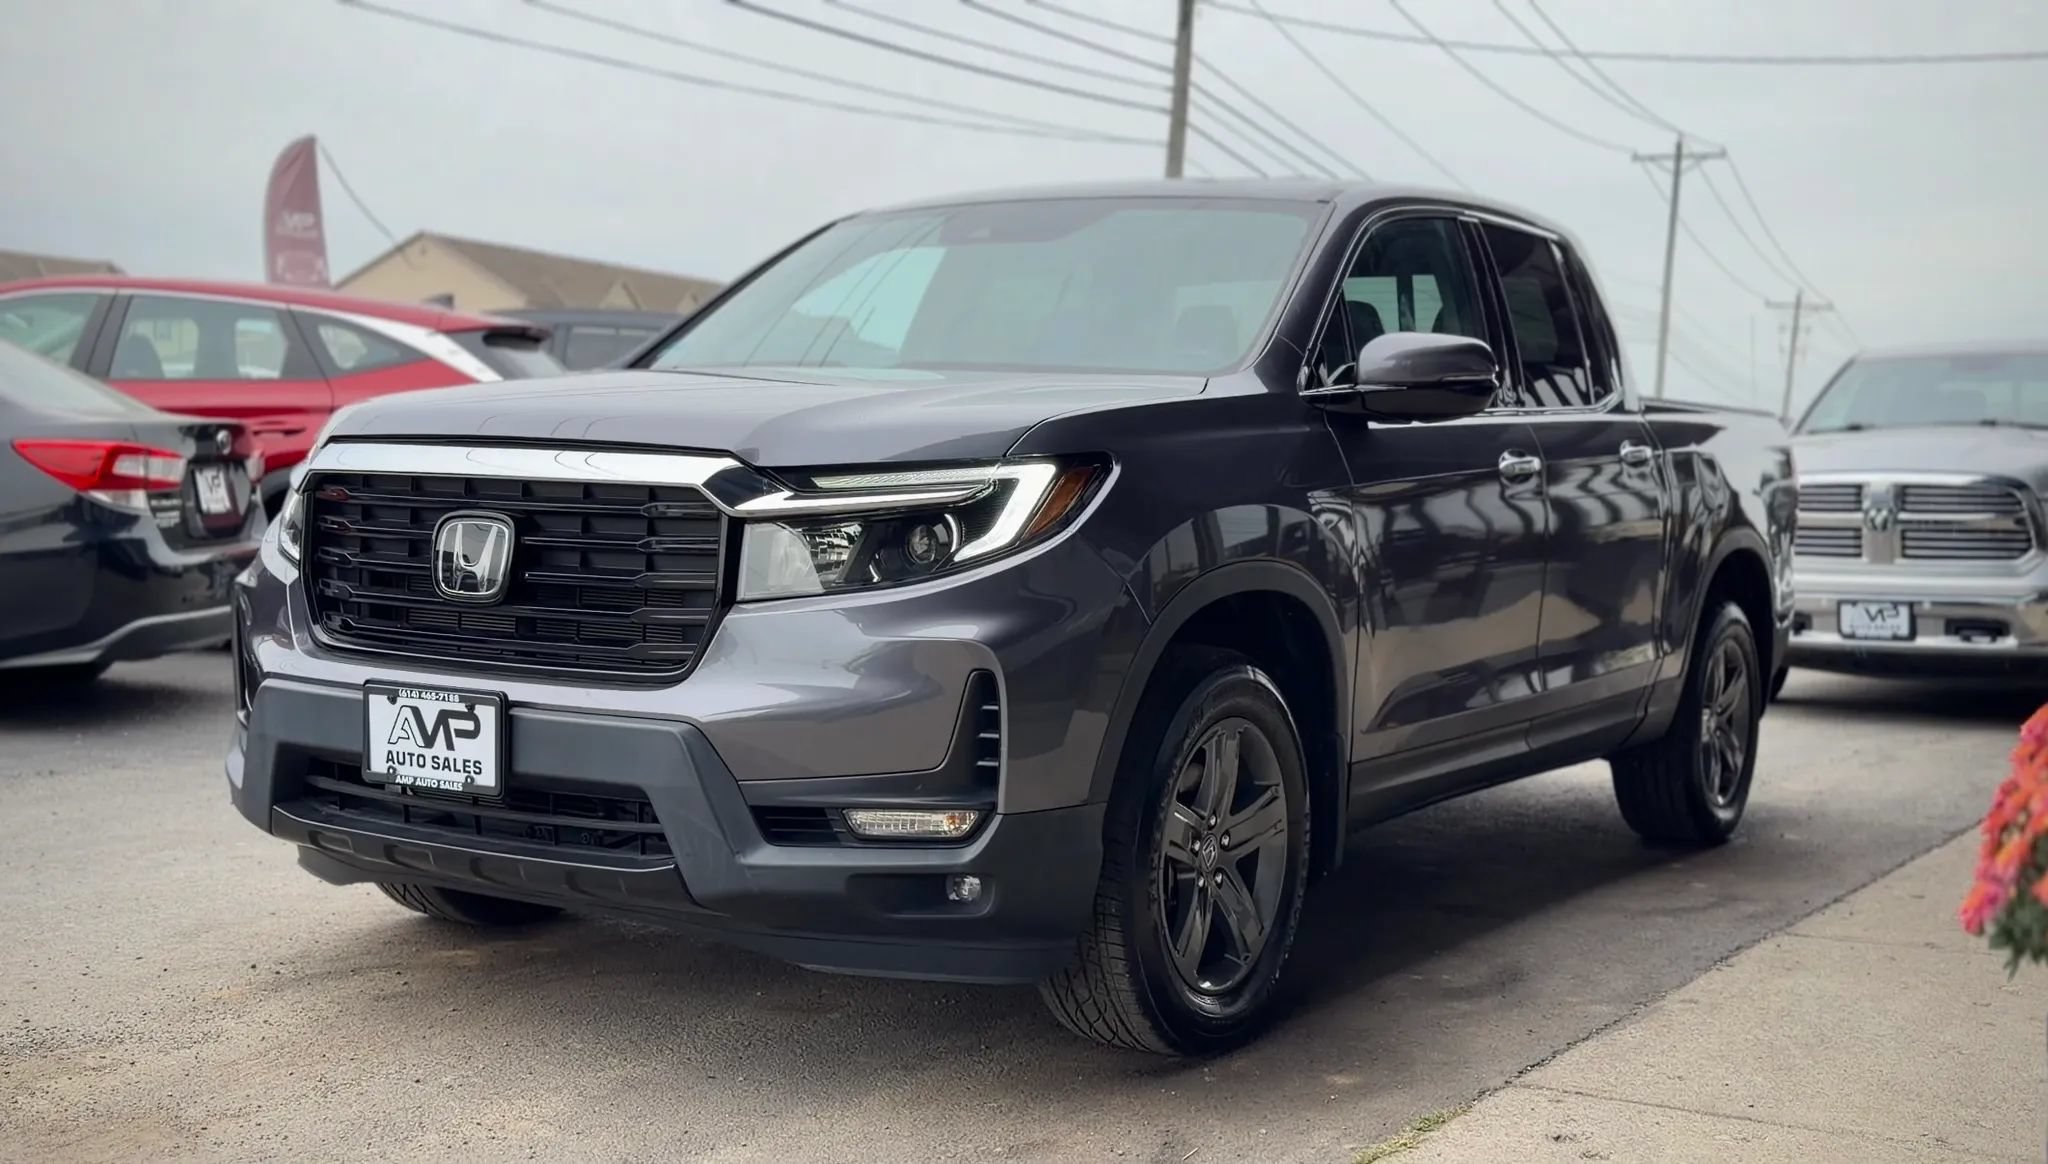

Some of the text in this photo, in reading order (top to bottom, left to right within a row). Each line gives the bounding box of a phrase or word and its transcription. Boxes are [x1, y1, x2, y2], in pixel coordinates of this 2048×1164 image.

[399, 689, 419, 698] (614)
[387, 704, 481, 751] AMP
[386, 750, 482, 775] AUTO SALES
[395, 775, 463, 791] AMP AUTO SALES
